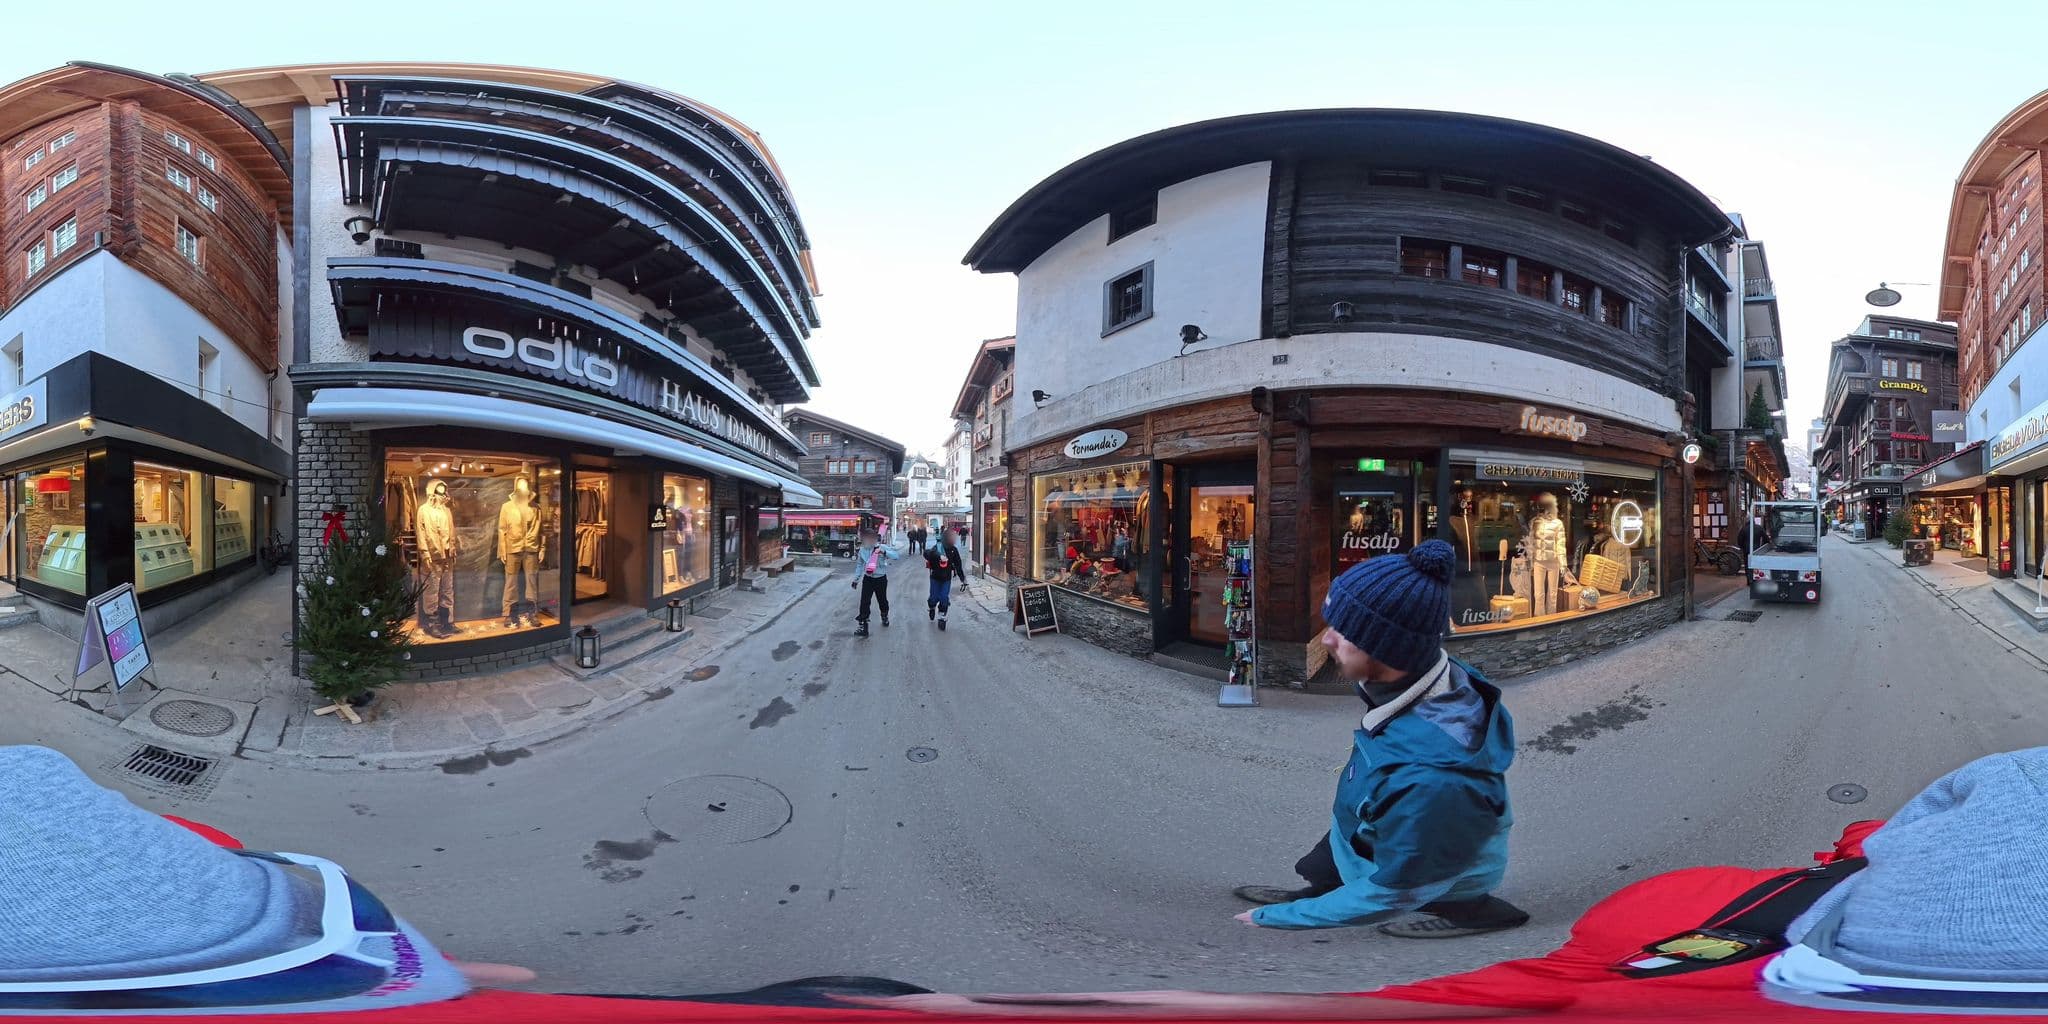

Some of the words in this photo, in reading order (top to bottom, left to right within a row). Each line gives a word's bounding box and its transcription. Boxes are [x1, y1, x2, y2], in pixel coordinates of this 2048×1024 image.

[463, 326, 618, 387] odlo
[661, 377, 720, 429] HAUS
[728, 414, 773, 457] DARIOLI
[1521, 406, 1587, 441] fusalp
[1071, 434, 1118, 455] Fernanda's
[1342, 531, 1400, 553] fusalp
